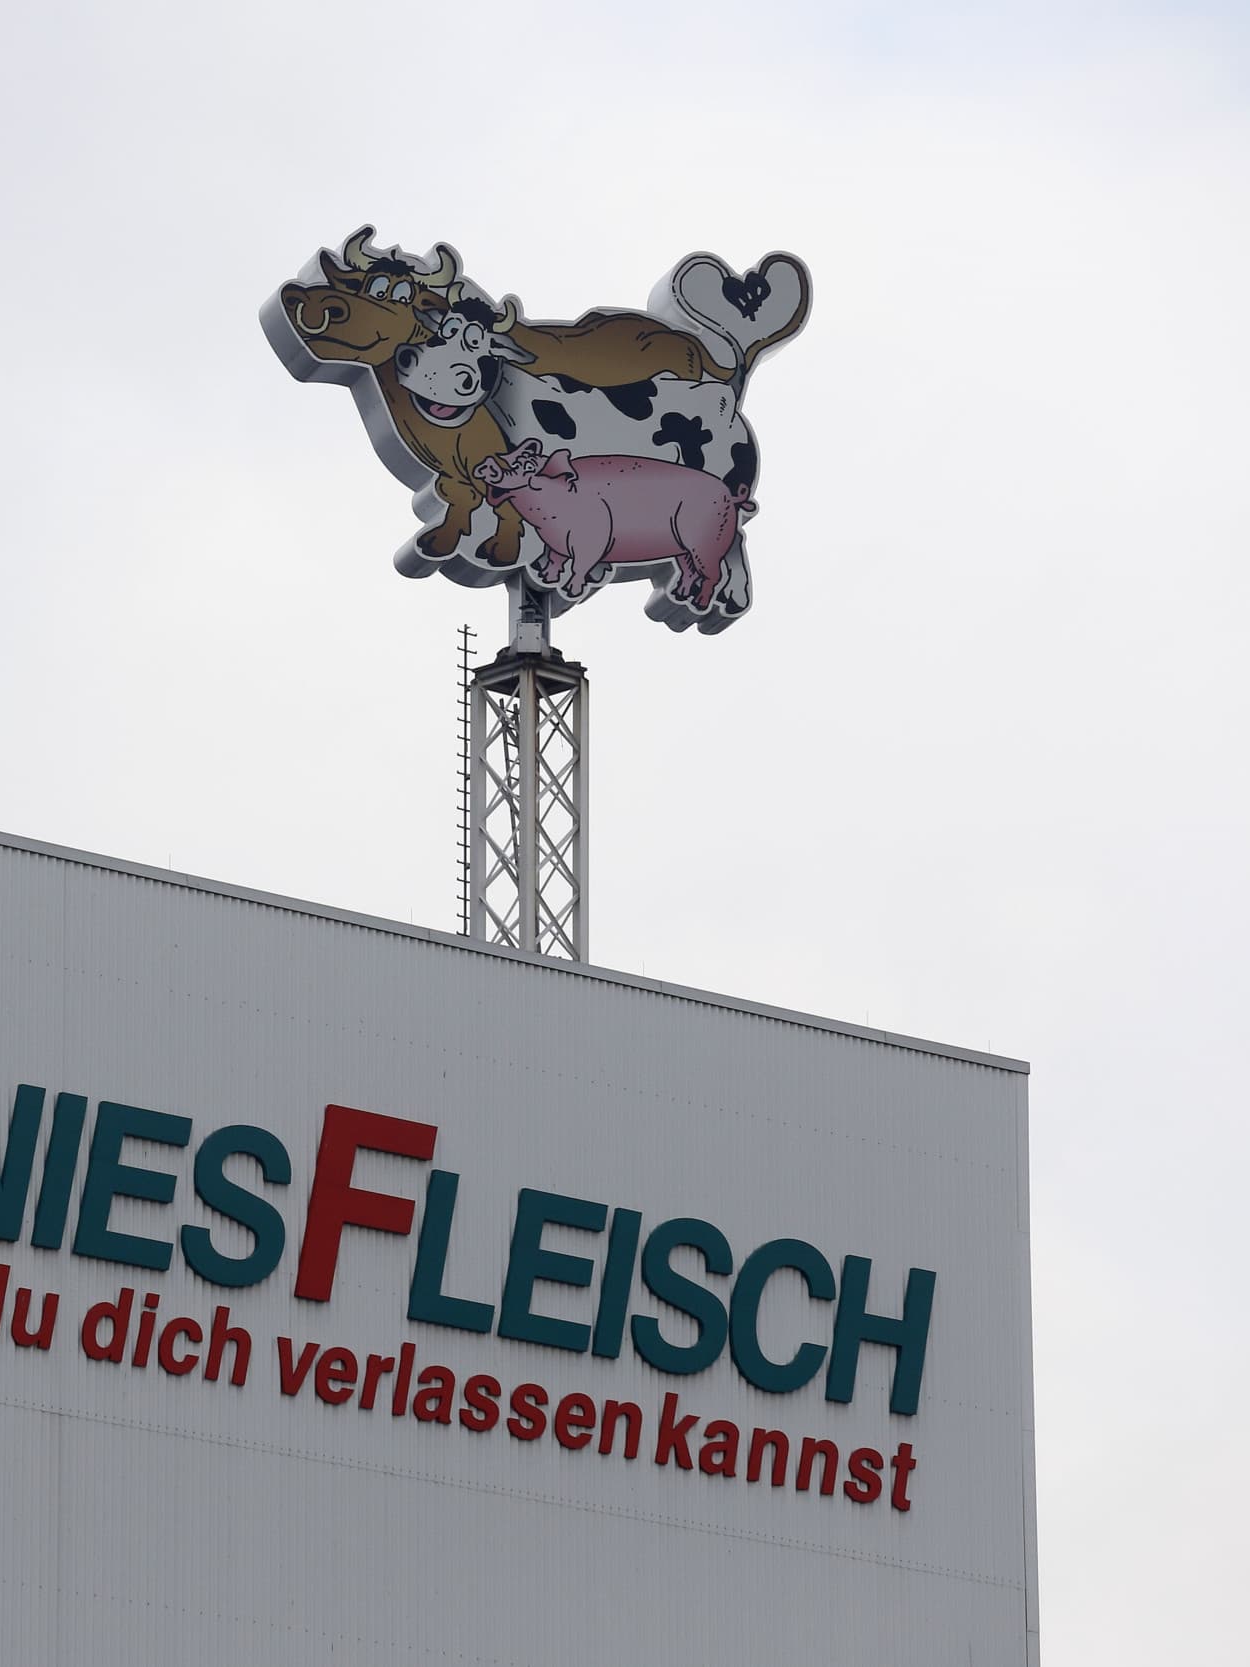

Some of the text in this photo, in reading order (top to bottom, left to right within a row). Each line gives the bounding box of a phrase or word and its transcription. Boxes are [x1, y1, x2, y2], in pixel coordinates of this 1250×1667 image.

[81, 1287, 252, 1387] dich
[277, 1336, 643, 1460] verlassen
[654, 1391, 917, 1512] kannst
